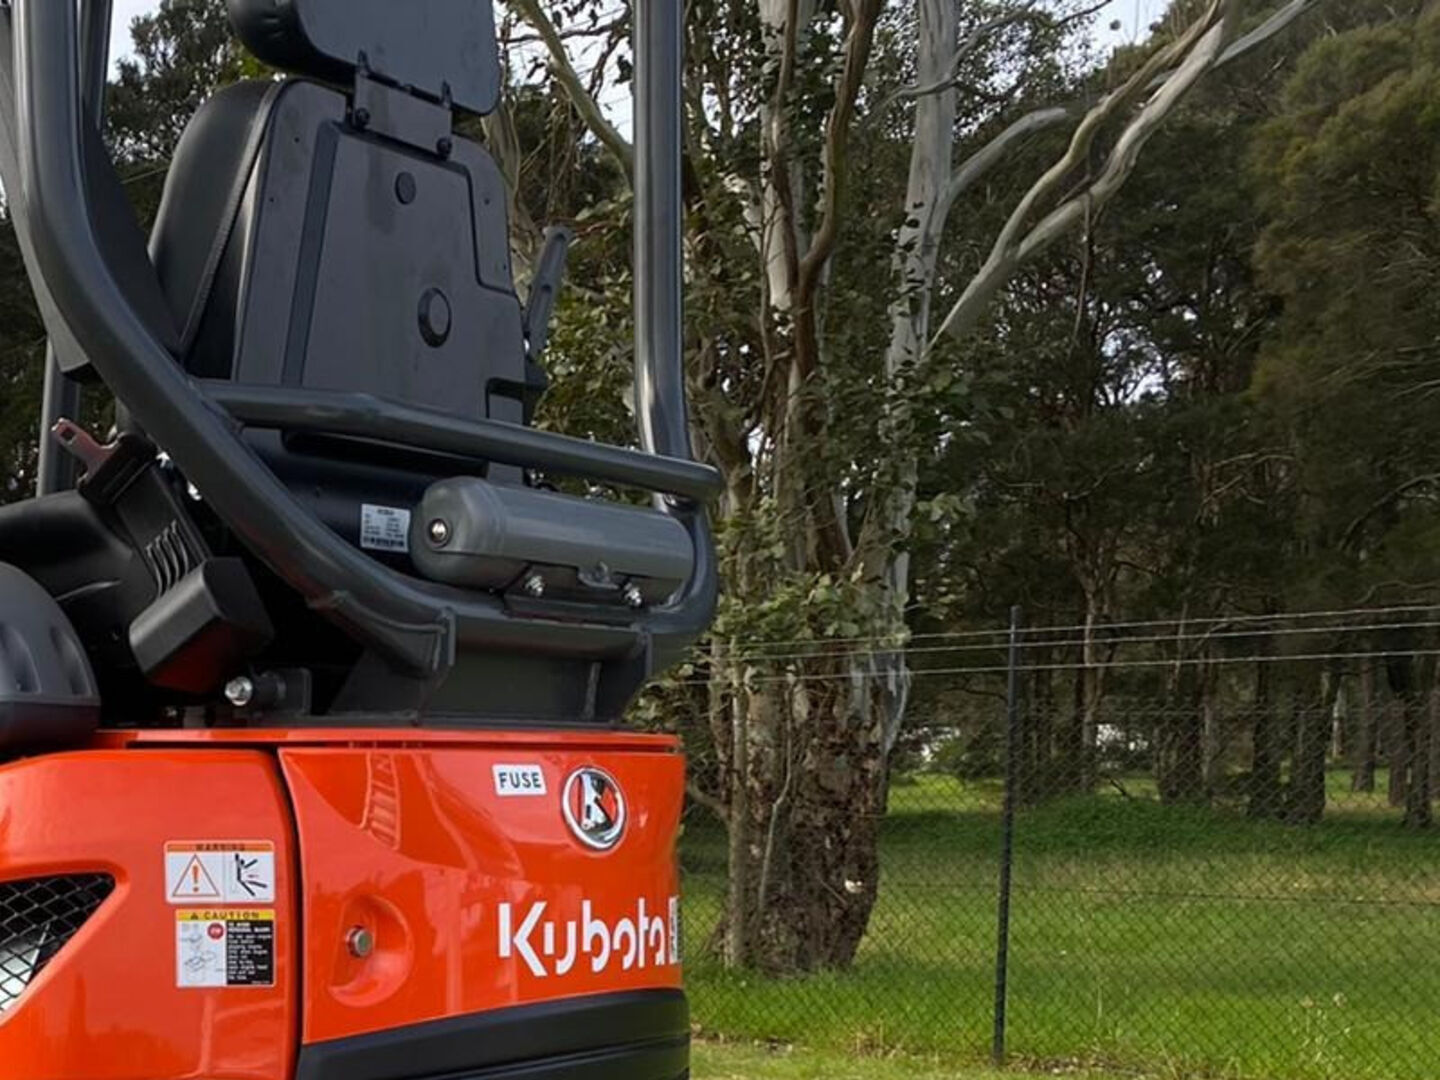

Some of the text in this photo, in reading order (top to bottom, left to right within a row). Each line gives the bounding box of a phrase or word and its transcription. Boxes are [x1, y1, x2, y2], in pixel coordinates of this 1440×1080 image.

[498, 771, 543, 789] FUSE
[204, 910, 260, 921] CAUTION
[498, 897, 666, 978] Kubota
